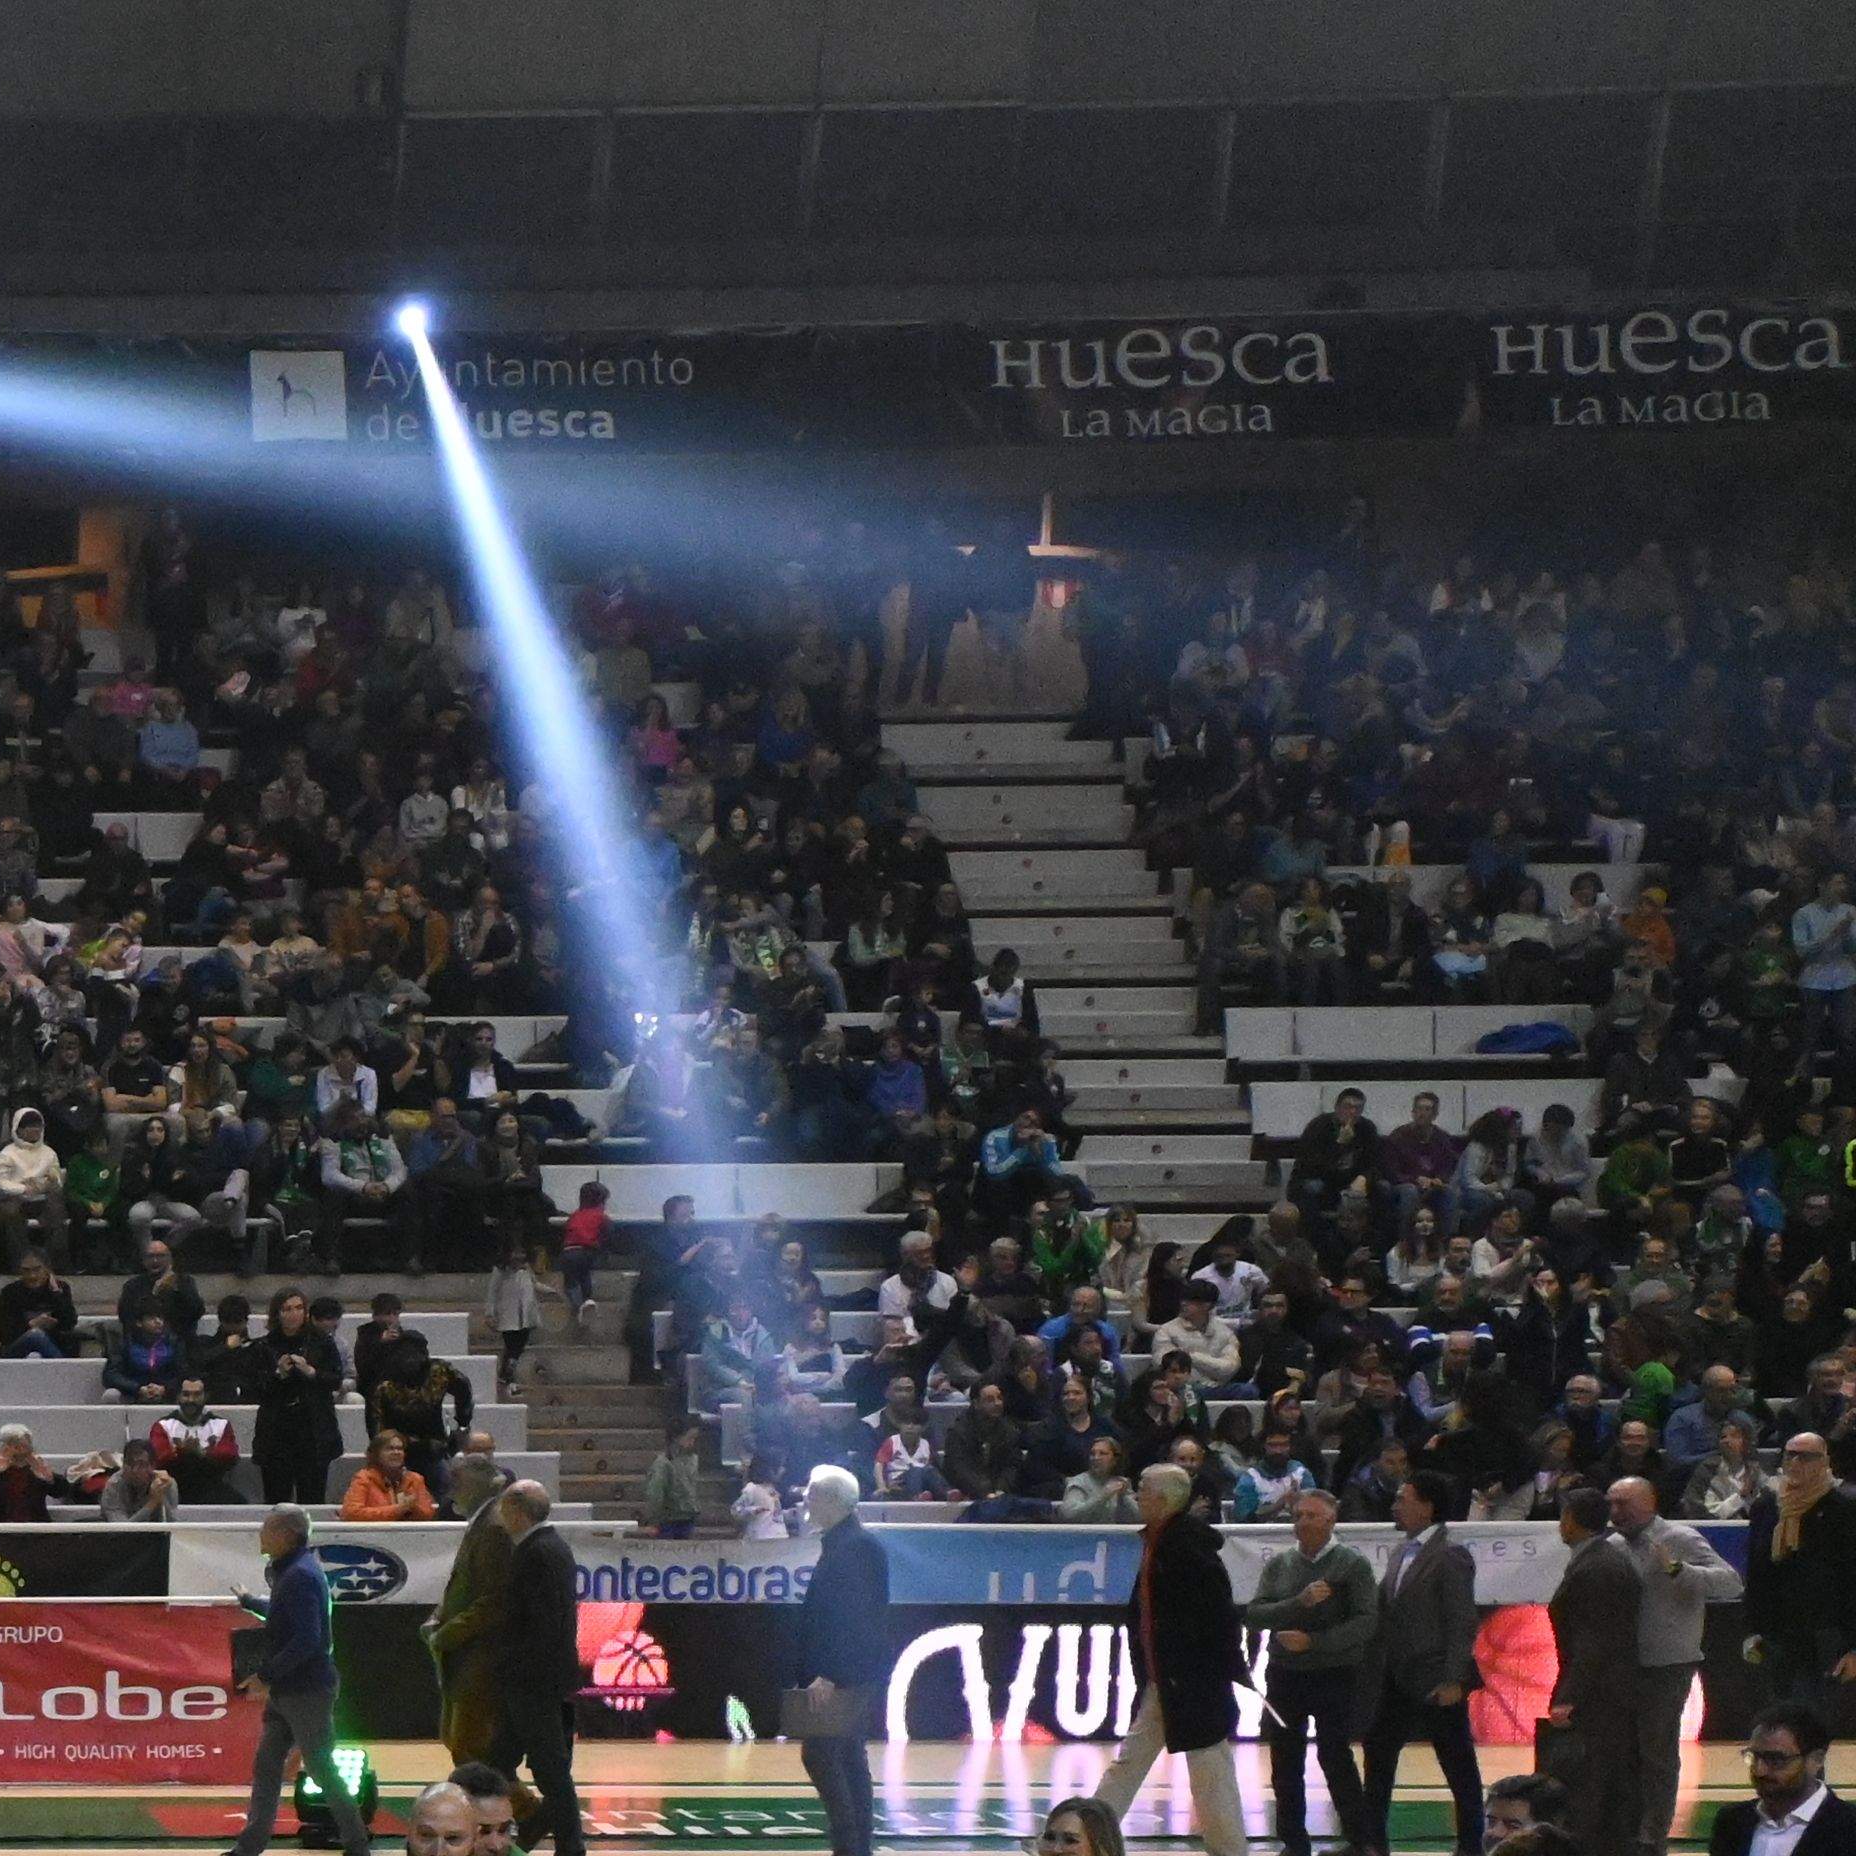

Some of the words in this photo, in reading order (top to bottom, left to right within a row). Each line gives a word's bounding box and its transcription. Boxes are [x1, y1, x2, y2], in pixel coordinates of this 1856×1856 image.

[367, 403, 419, 441] de
[1060, 408, 1112, 440] La
[1550, 394, 1606, 428] La
[15, 1745, 55, 1760] HIGH
[65, 1745, 136, 1761] QUALITY
[146, 1744, 206, 1760] HOMES
